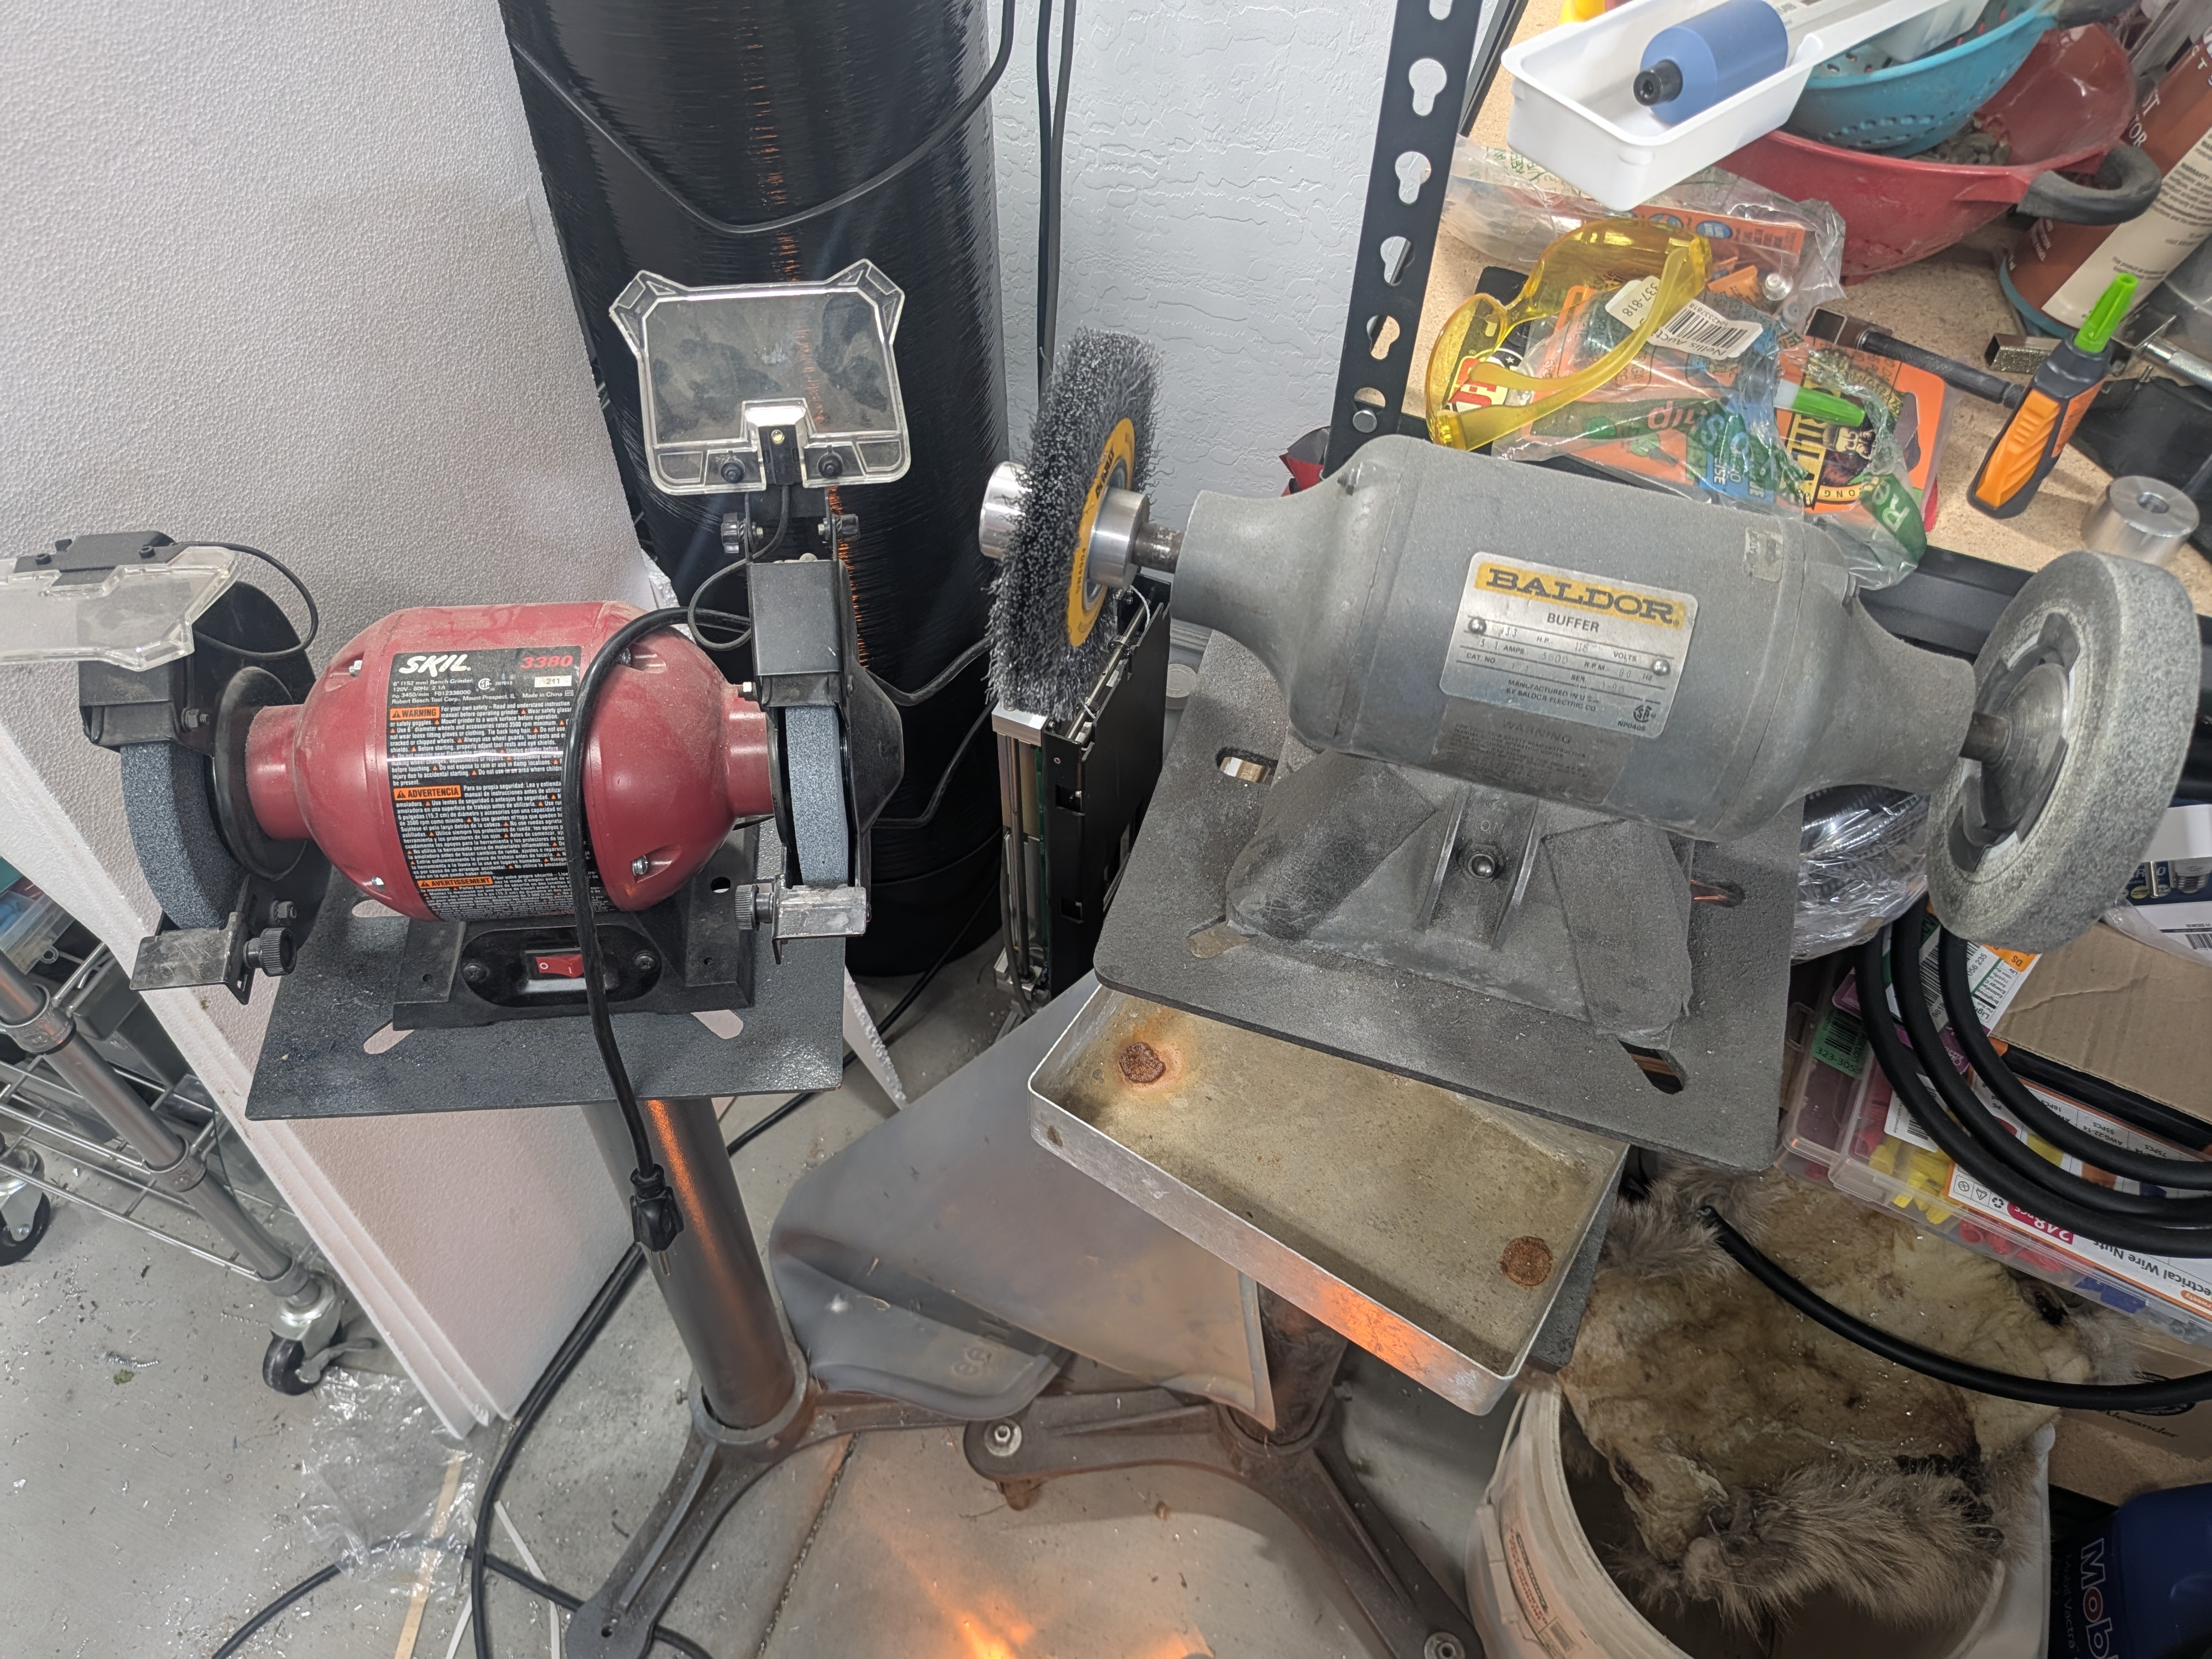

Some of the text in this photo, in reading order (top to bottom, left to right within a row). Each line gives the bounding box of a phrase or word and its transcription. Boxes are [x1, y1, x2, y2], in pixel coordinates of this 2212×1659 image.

[1689, 303, 1728, 326] 1042337818
[1689, 341, 1726, 356] Nellis
[1486, 568, 1673, 625] BALDOR
[1547, 613, 1600, 634] BUFFER
[520, 655, 573, 669] 3380
[1613, 651, 1637, 662] VOLTS
[1507, 679, 1569, 697] MANUFACTURED
[1517, 690, 1547, 702] BALDOR
[1548, 696, 1583, 709] ELECTRIC
[402, 708, 436, 718] WARNING
[1503, 720, 1572, 744] WARNING
[408, 787, 460, 798] ADVERTENCIA
[431, 878, 490, 886] AVERTISSEMENT
[1975, 953, 1987, 966] 235
[2092, 1121, 2115, 1135] 55PCS
[2145, 1143, 2167, 1157] 75PCS
[2093, 1240, 2212, 1296] ectrical Wire Nuts
[2064, 1597, 2075, 1648] Vactra
